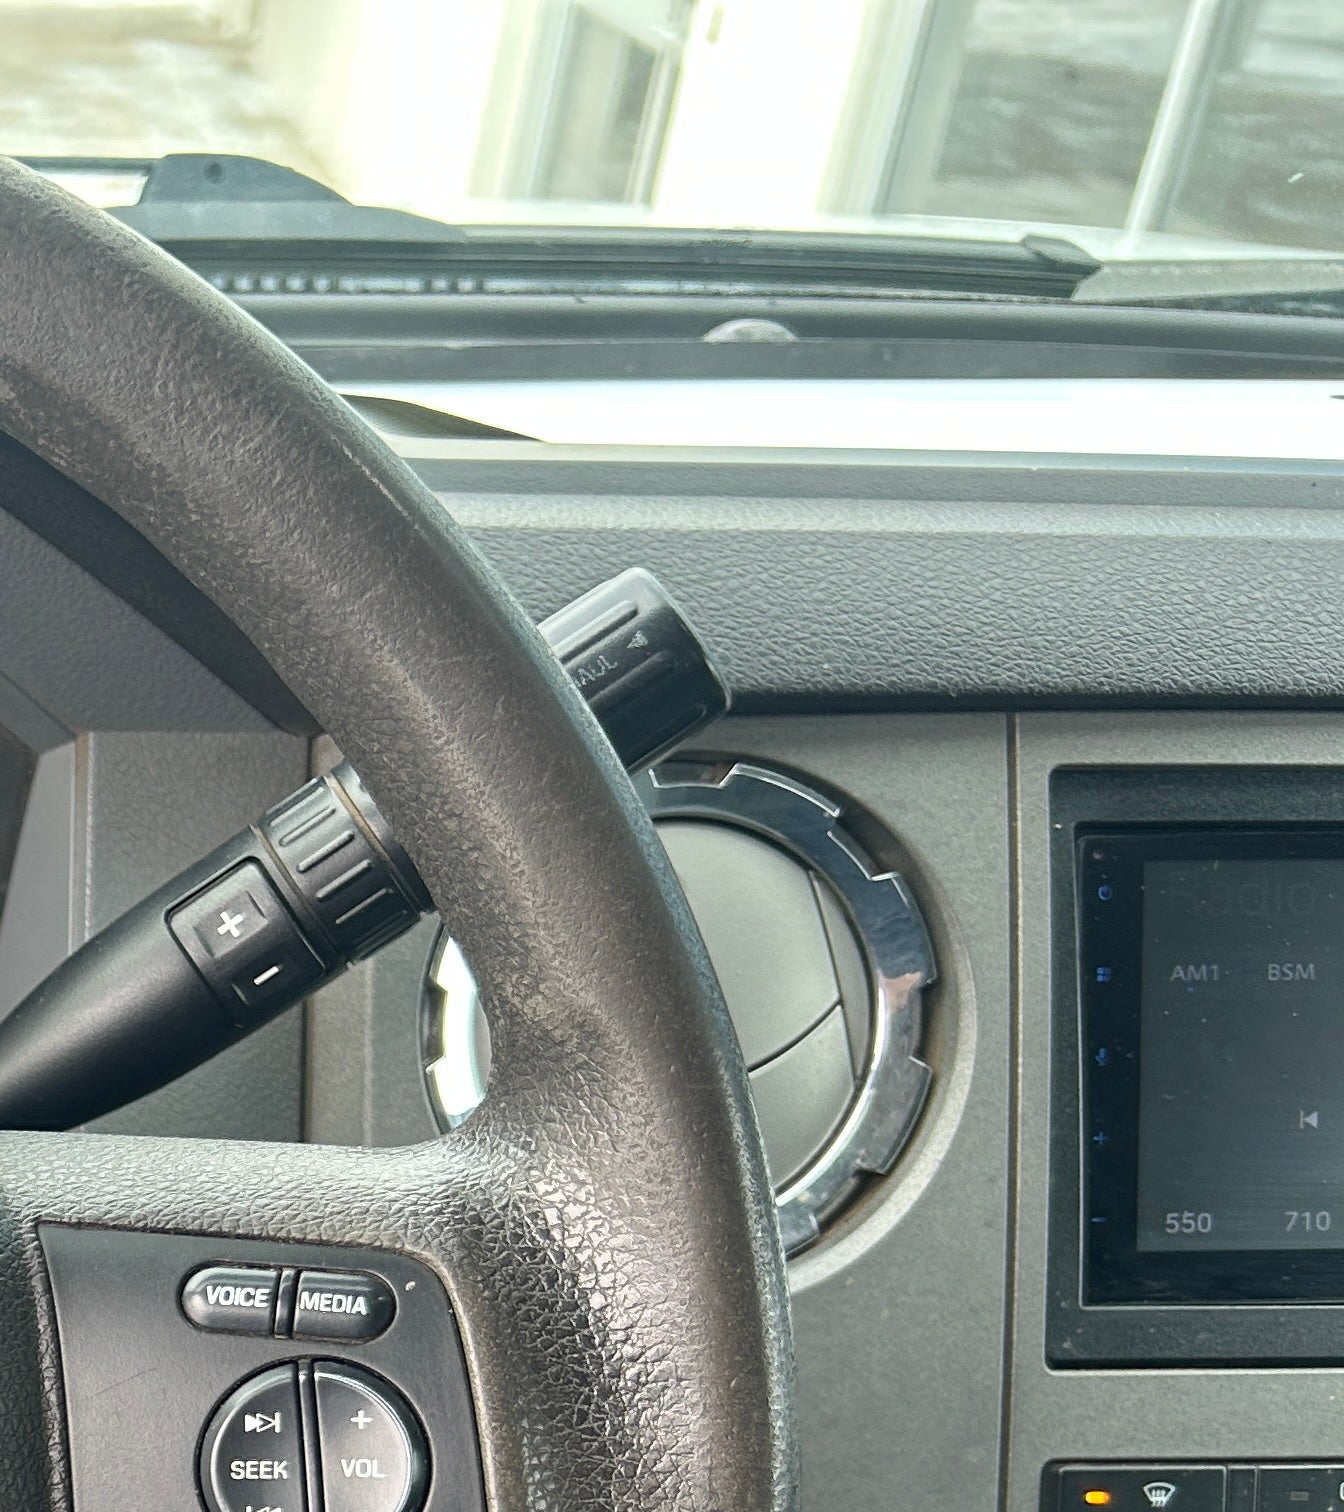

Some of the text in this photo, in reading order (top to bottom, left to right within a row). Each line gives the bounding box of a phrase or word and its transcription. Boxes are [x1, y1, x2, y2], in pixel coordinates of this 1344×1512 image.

[1267, 963, 1317, 982] BSM
[1165, 1211, 1331, 1234] 550 710
[206, 1286, 367, 1316] VOICE MEDIA
[230, 1460, 288, 1480] SEEK
[341, 1459, 385, 1478] VOL
